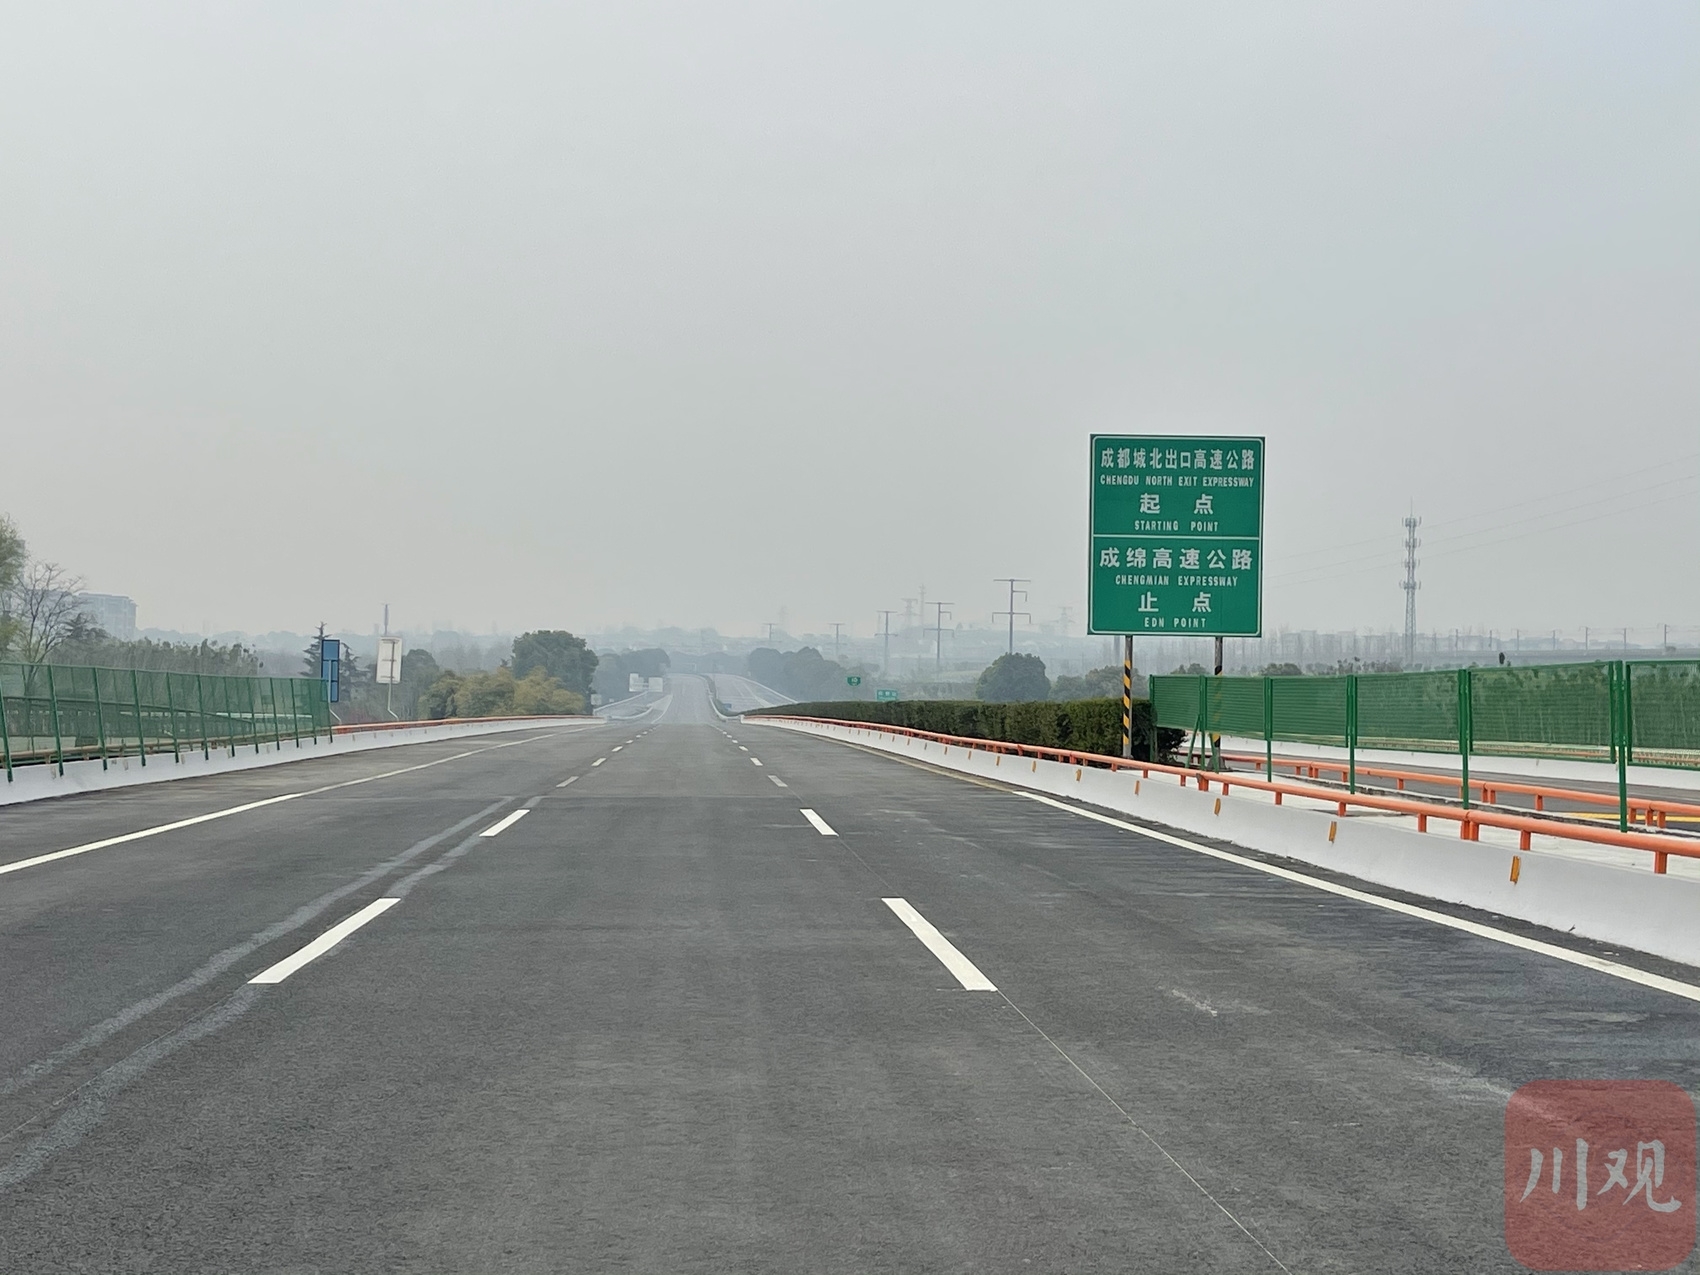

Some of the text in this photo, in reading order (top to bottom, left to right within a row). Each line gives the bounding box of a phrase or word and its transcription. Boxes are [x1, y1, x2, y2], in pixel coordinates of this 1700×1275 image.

[1100, 447, 1255, 470] 成都城北出口高速公路
[1100, 474, 1254, 488] CHENGDU NORTH EXIT EXPRESSWAY
[1134, 520, 1219, 532] STARTING POINT
[1099, 547, 1253, 570] 成绵高速公路
[1115, 574, 1238, 587] CHENGMIAN EXPRESSWAY
[1144, 616, 1207, 628] EDN POINT
